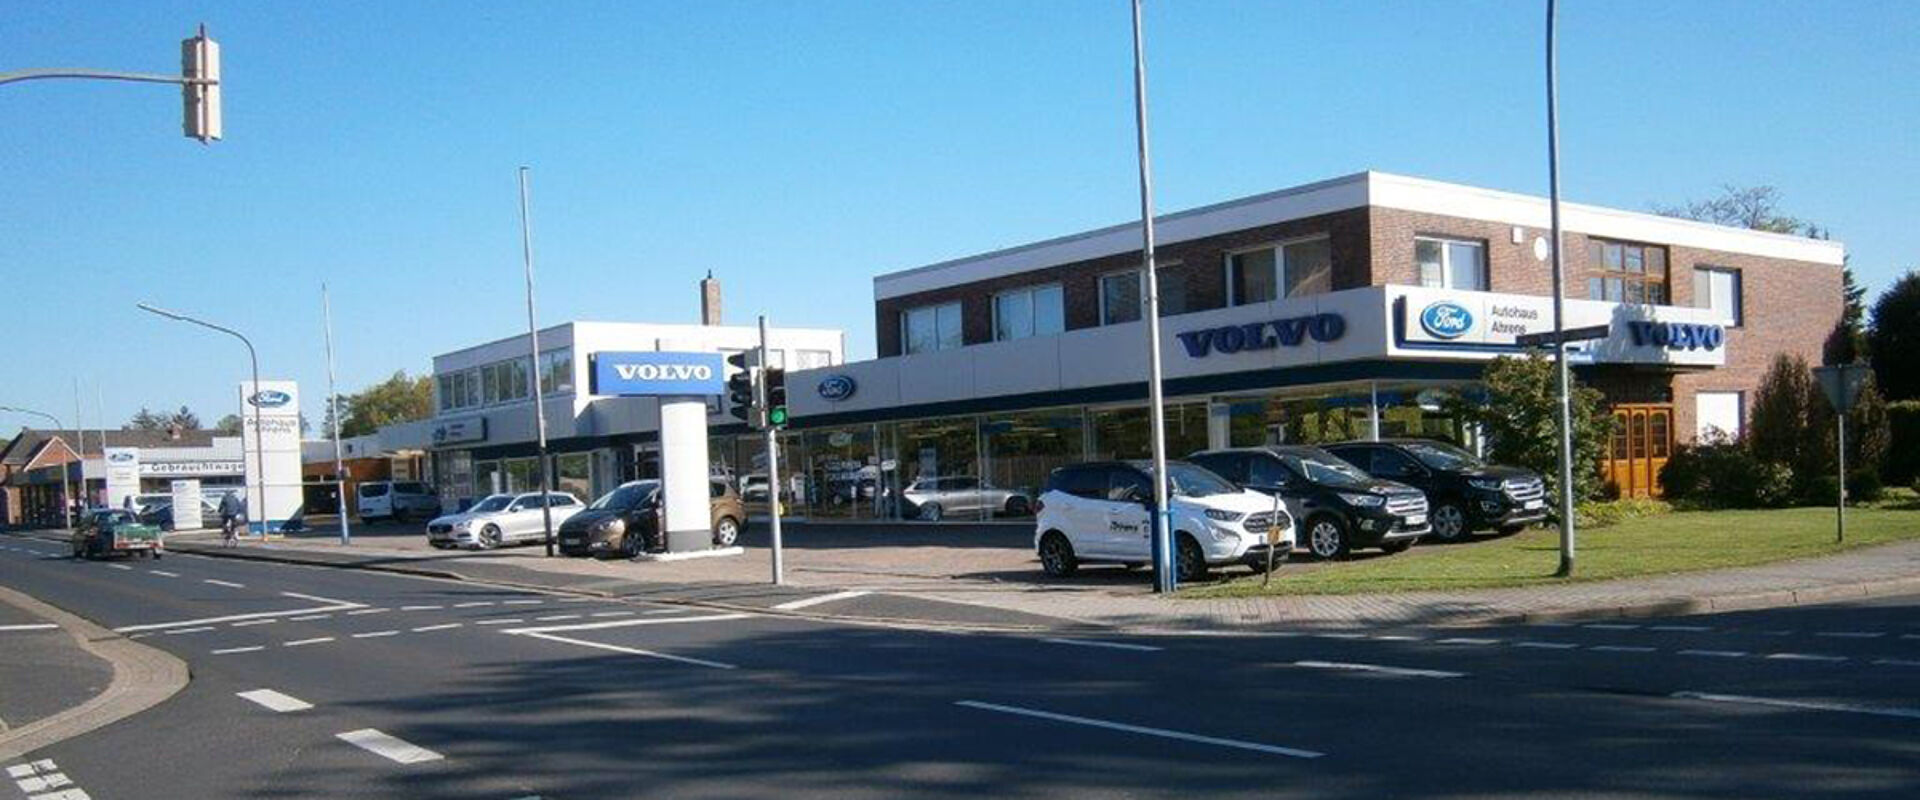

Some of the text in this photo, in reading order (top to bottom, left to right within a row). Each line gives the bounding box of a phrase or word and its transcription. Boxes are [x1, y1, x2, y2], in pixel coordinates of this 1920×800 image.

[1432, 304, 1467, 331] Ford
[1492, 305, 1538, 320] Autohaus
[1176, 313, 1347, 358] VOLVO
[1492, 322, 1527, 335] Ahrens
[1627, 321, 1725, 351] VOLVO
[614, 364, 712, 380] VOLVO
[151, 462, 245, 472] Gebrauchtwage
